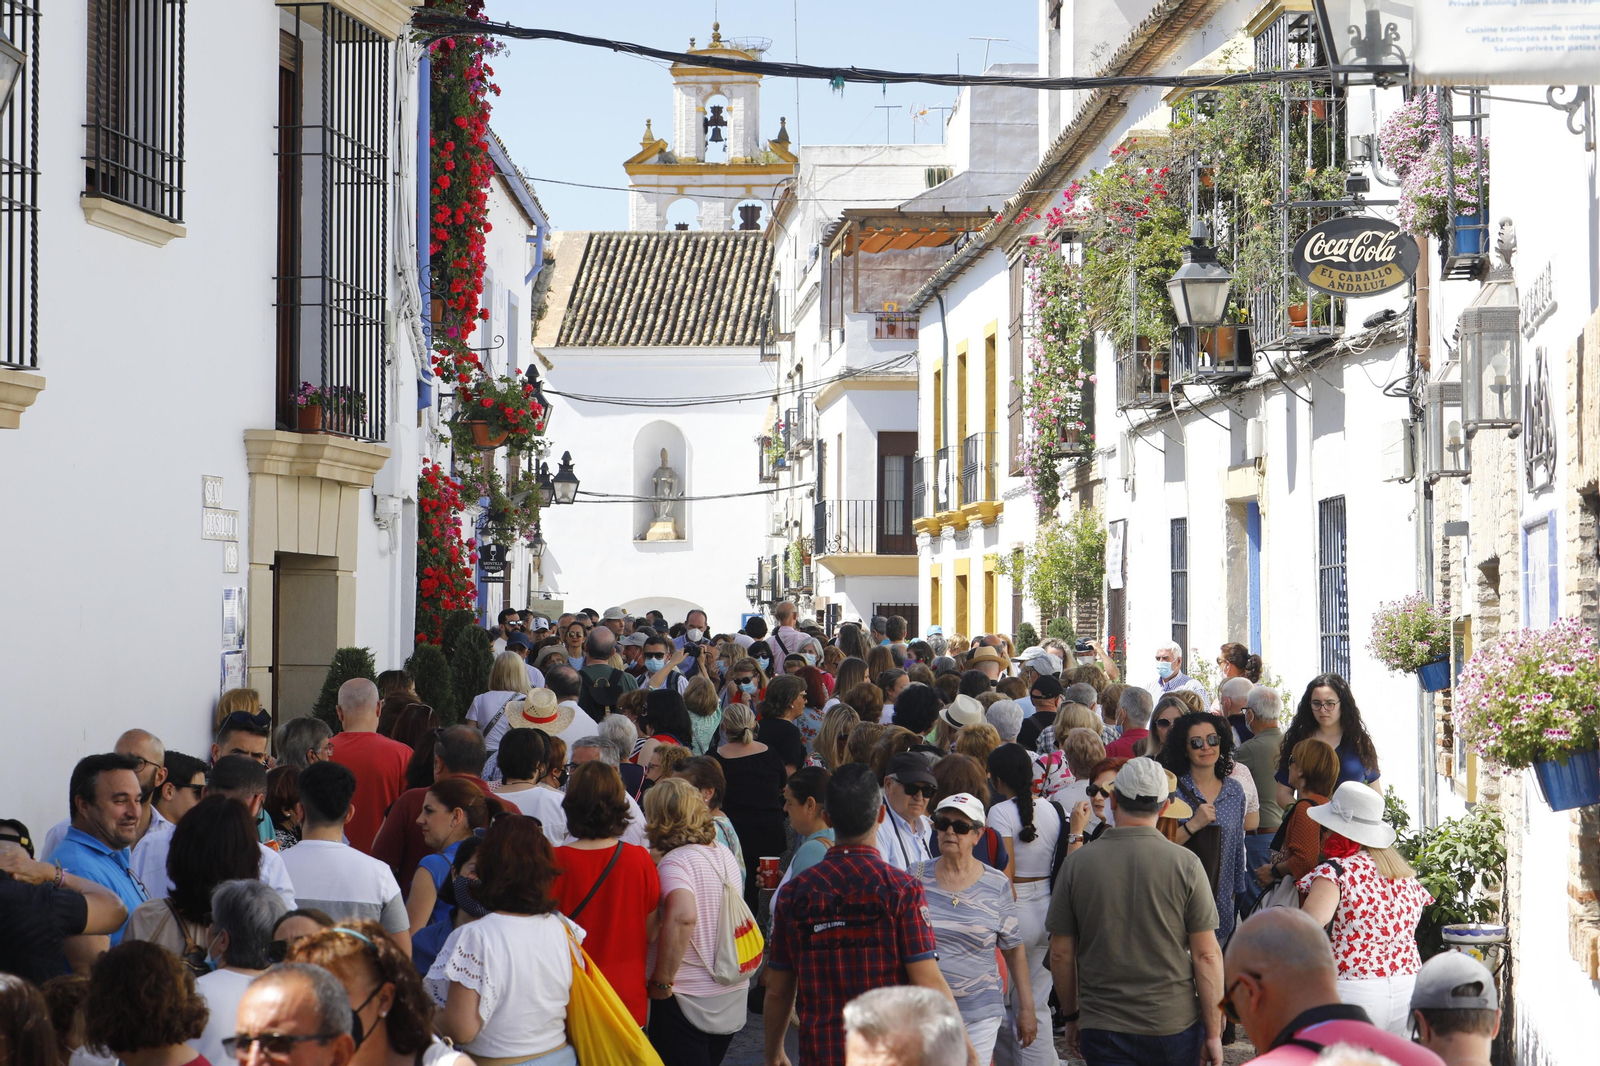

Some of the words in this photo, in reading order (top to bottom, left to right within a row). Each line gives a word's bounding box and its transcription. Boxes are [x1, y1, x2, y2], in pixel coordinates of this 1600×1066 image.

[1465, 26, 1498, 34] Cuisine
[1501, 24, 1562, 32] traditionnelle
[1506, 35, 1540, 43] mijotés
[1568, 44, 1596, 52] patios
[1304, 231, 1400, 263] Coca-Cola
[1320, 267, 1334, 279] EL
[1338, 267, 1393, 282] CABALLO
[1327, 279, 1387, 292] ANDALUZ
[206, 482, 221, 501] SAN
[205, 515, 238, 537] BASILIO
